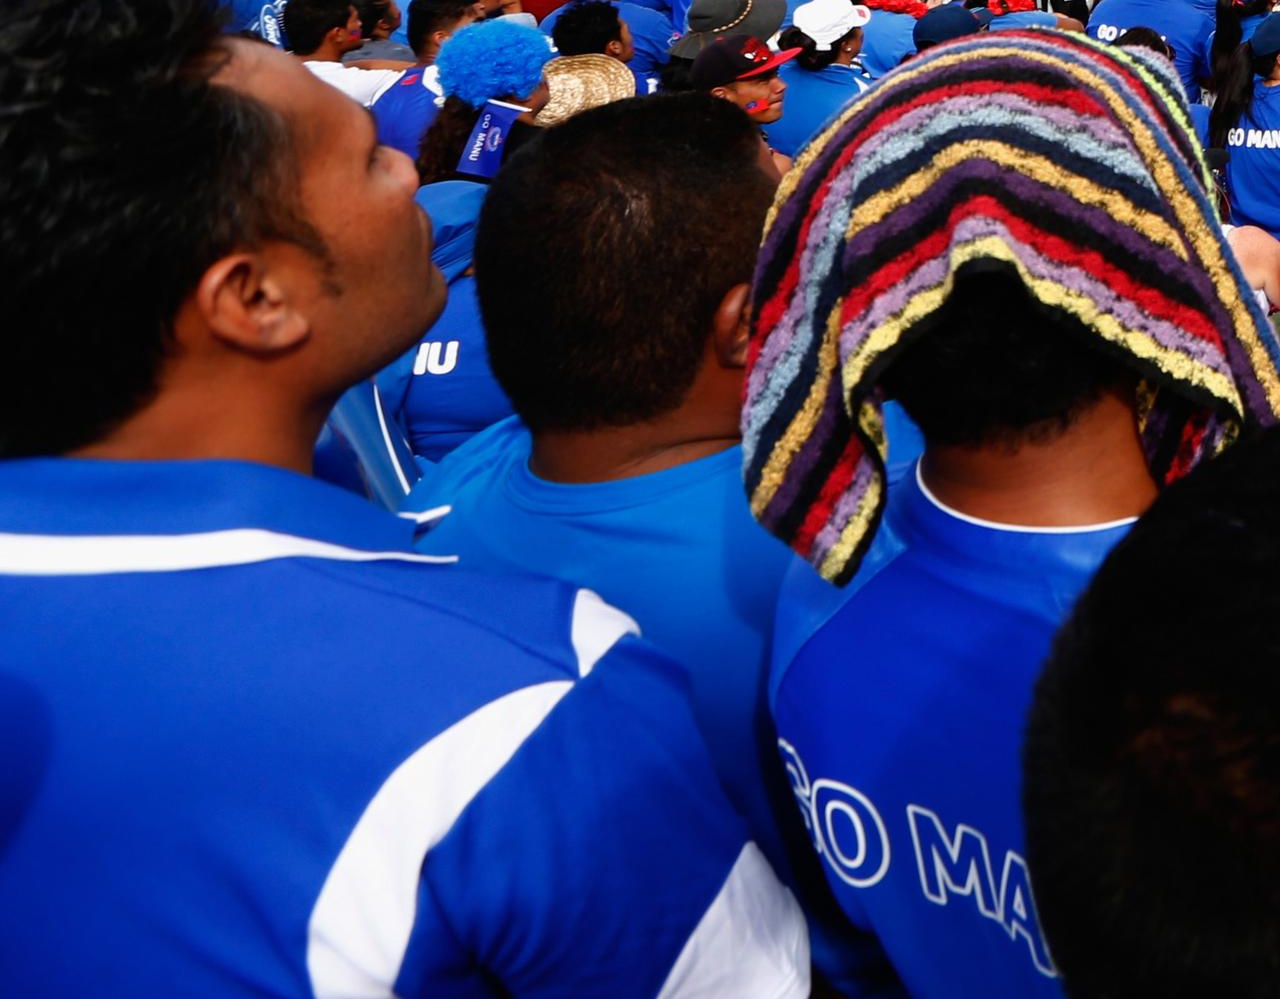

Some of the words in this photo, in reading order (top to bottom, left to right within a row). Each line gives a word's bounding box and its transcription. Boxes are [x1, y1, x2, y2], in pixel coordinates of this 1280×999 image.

[1097, 24, 1118, 41] GO
[468, 132, 487, 162] MANU
[1228, 128, 1244, 147] GO
[905, 803, 1062, 979] MA
